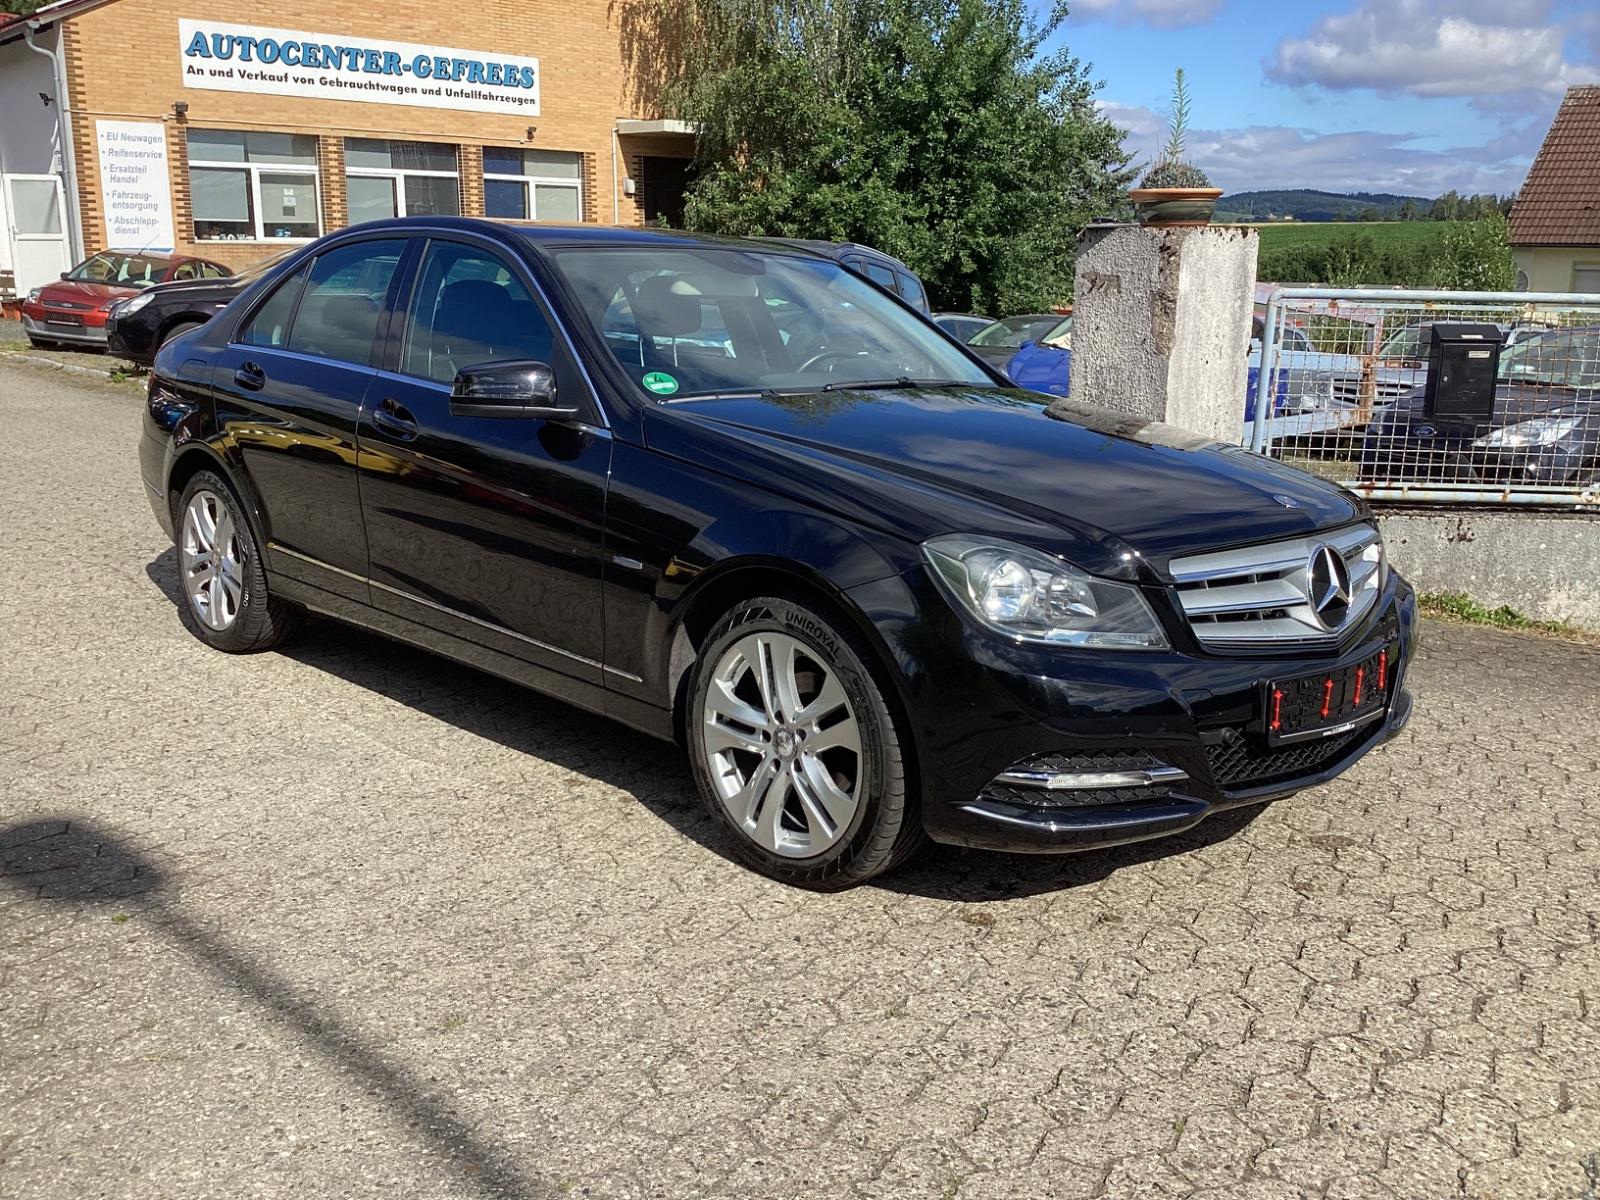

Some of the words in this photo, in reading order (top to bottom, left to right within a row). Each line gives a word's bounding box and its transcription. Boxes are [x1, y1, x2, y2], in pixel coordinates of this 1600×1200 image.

[185, 31, 535, 89] AUTOCENTER-GEFREES
[187, 65, 204, 76] An
[209, 68, 234, 78] und
[238, 69, 288, 83] Verkauf
[293, 76, 315, 85] von
[320, 77, 417, 94] Gebrauchtwagen
[421, 87, 442, 97] und
[445, 88, 536, 106] Unfallfahrzeugen
[106, 131, 118, 141] EU
[120, 132, 163, 145] Neuwagen
[108, 148, 163, 159] Reifenservice
[109, 164, 147, 174] Ersatzteil
[110, 174, 139, 184] Handel
[111, 190, 152, 201] Fahrzeug-
[112, 201, 159, 212] entsorgung
[114, 215, 159, 226] Abschlepp-
[114, 226, 140, 235] dienst
[785, 609, 840, 660] UNIROYAL
